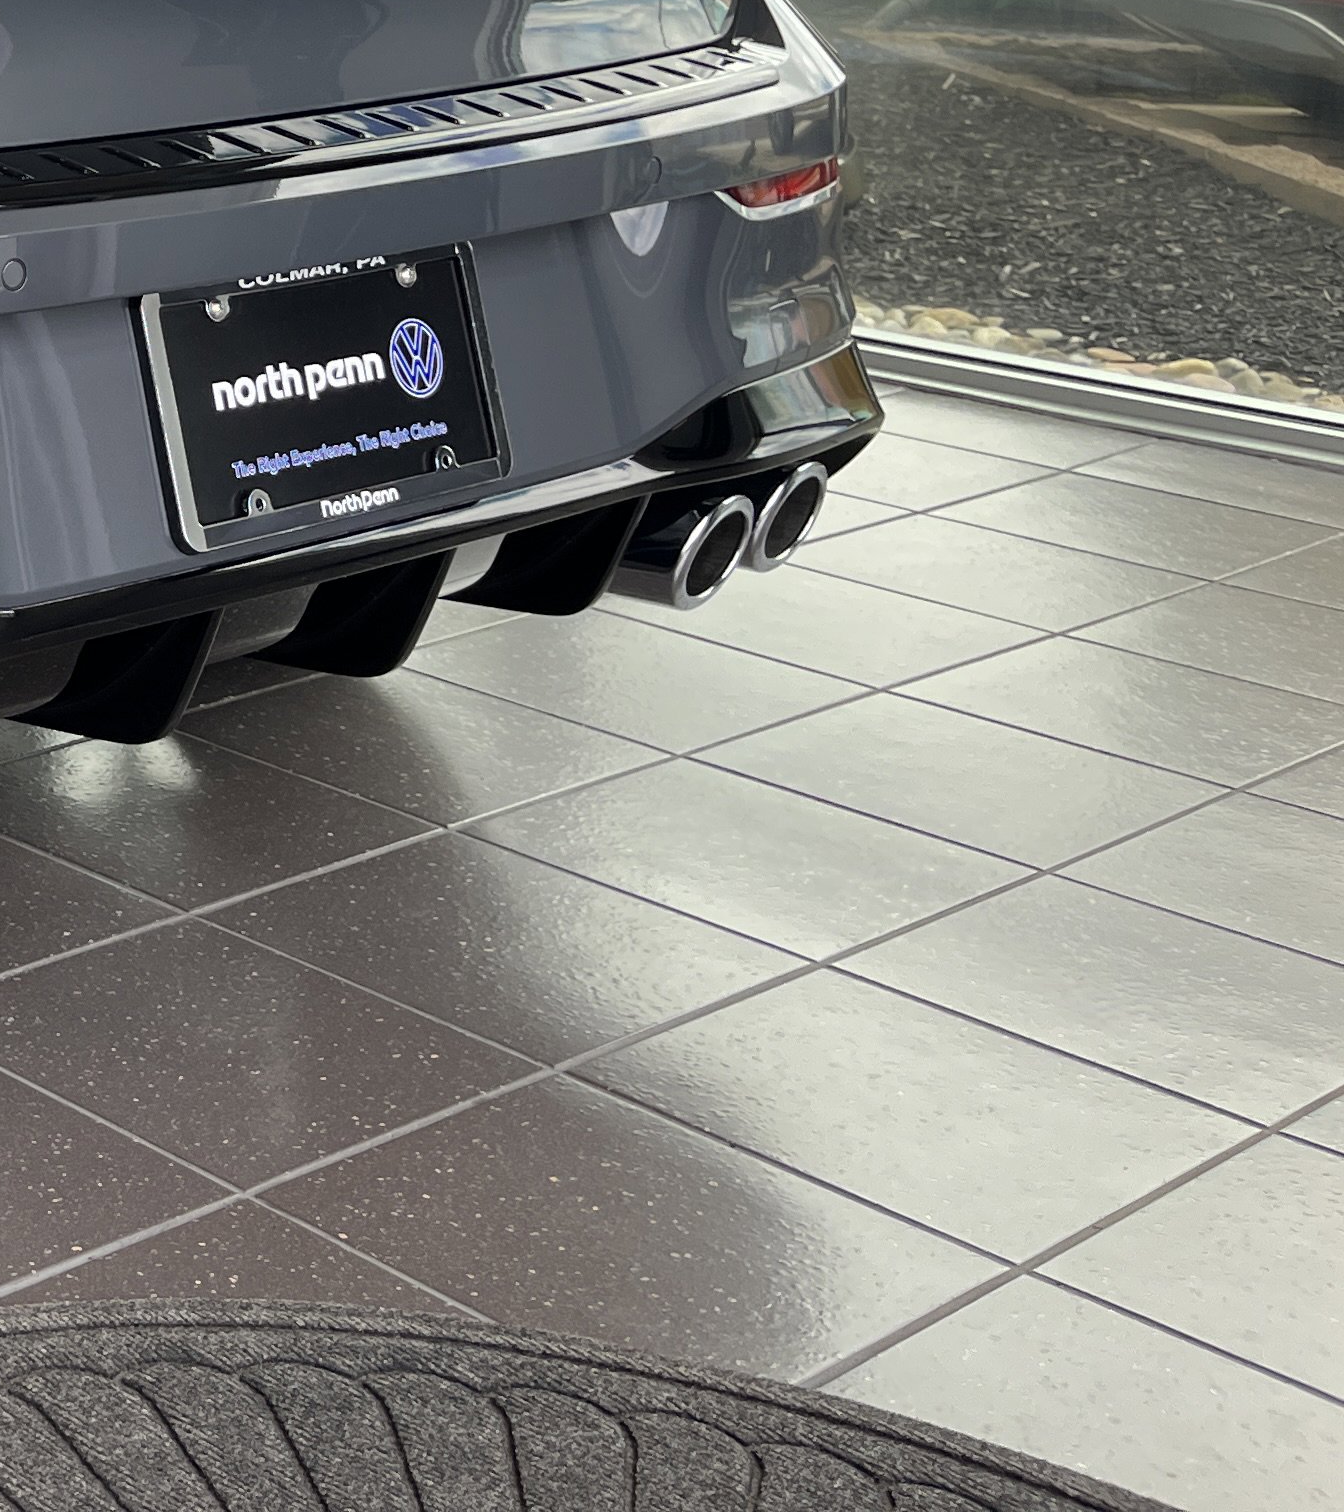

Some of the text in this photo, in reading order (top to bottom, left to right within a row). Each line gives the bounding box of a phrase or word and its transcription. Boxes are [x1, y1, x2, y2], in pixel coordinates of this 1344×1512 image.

[232, 460, 256, 478] The
[257, 451, 290, 475] Right
[356, 434, 379, 452] The
[379, 427, 411, 449] Right
[411, 420, 447, 440] Choice
